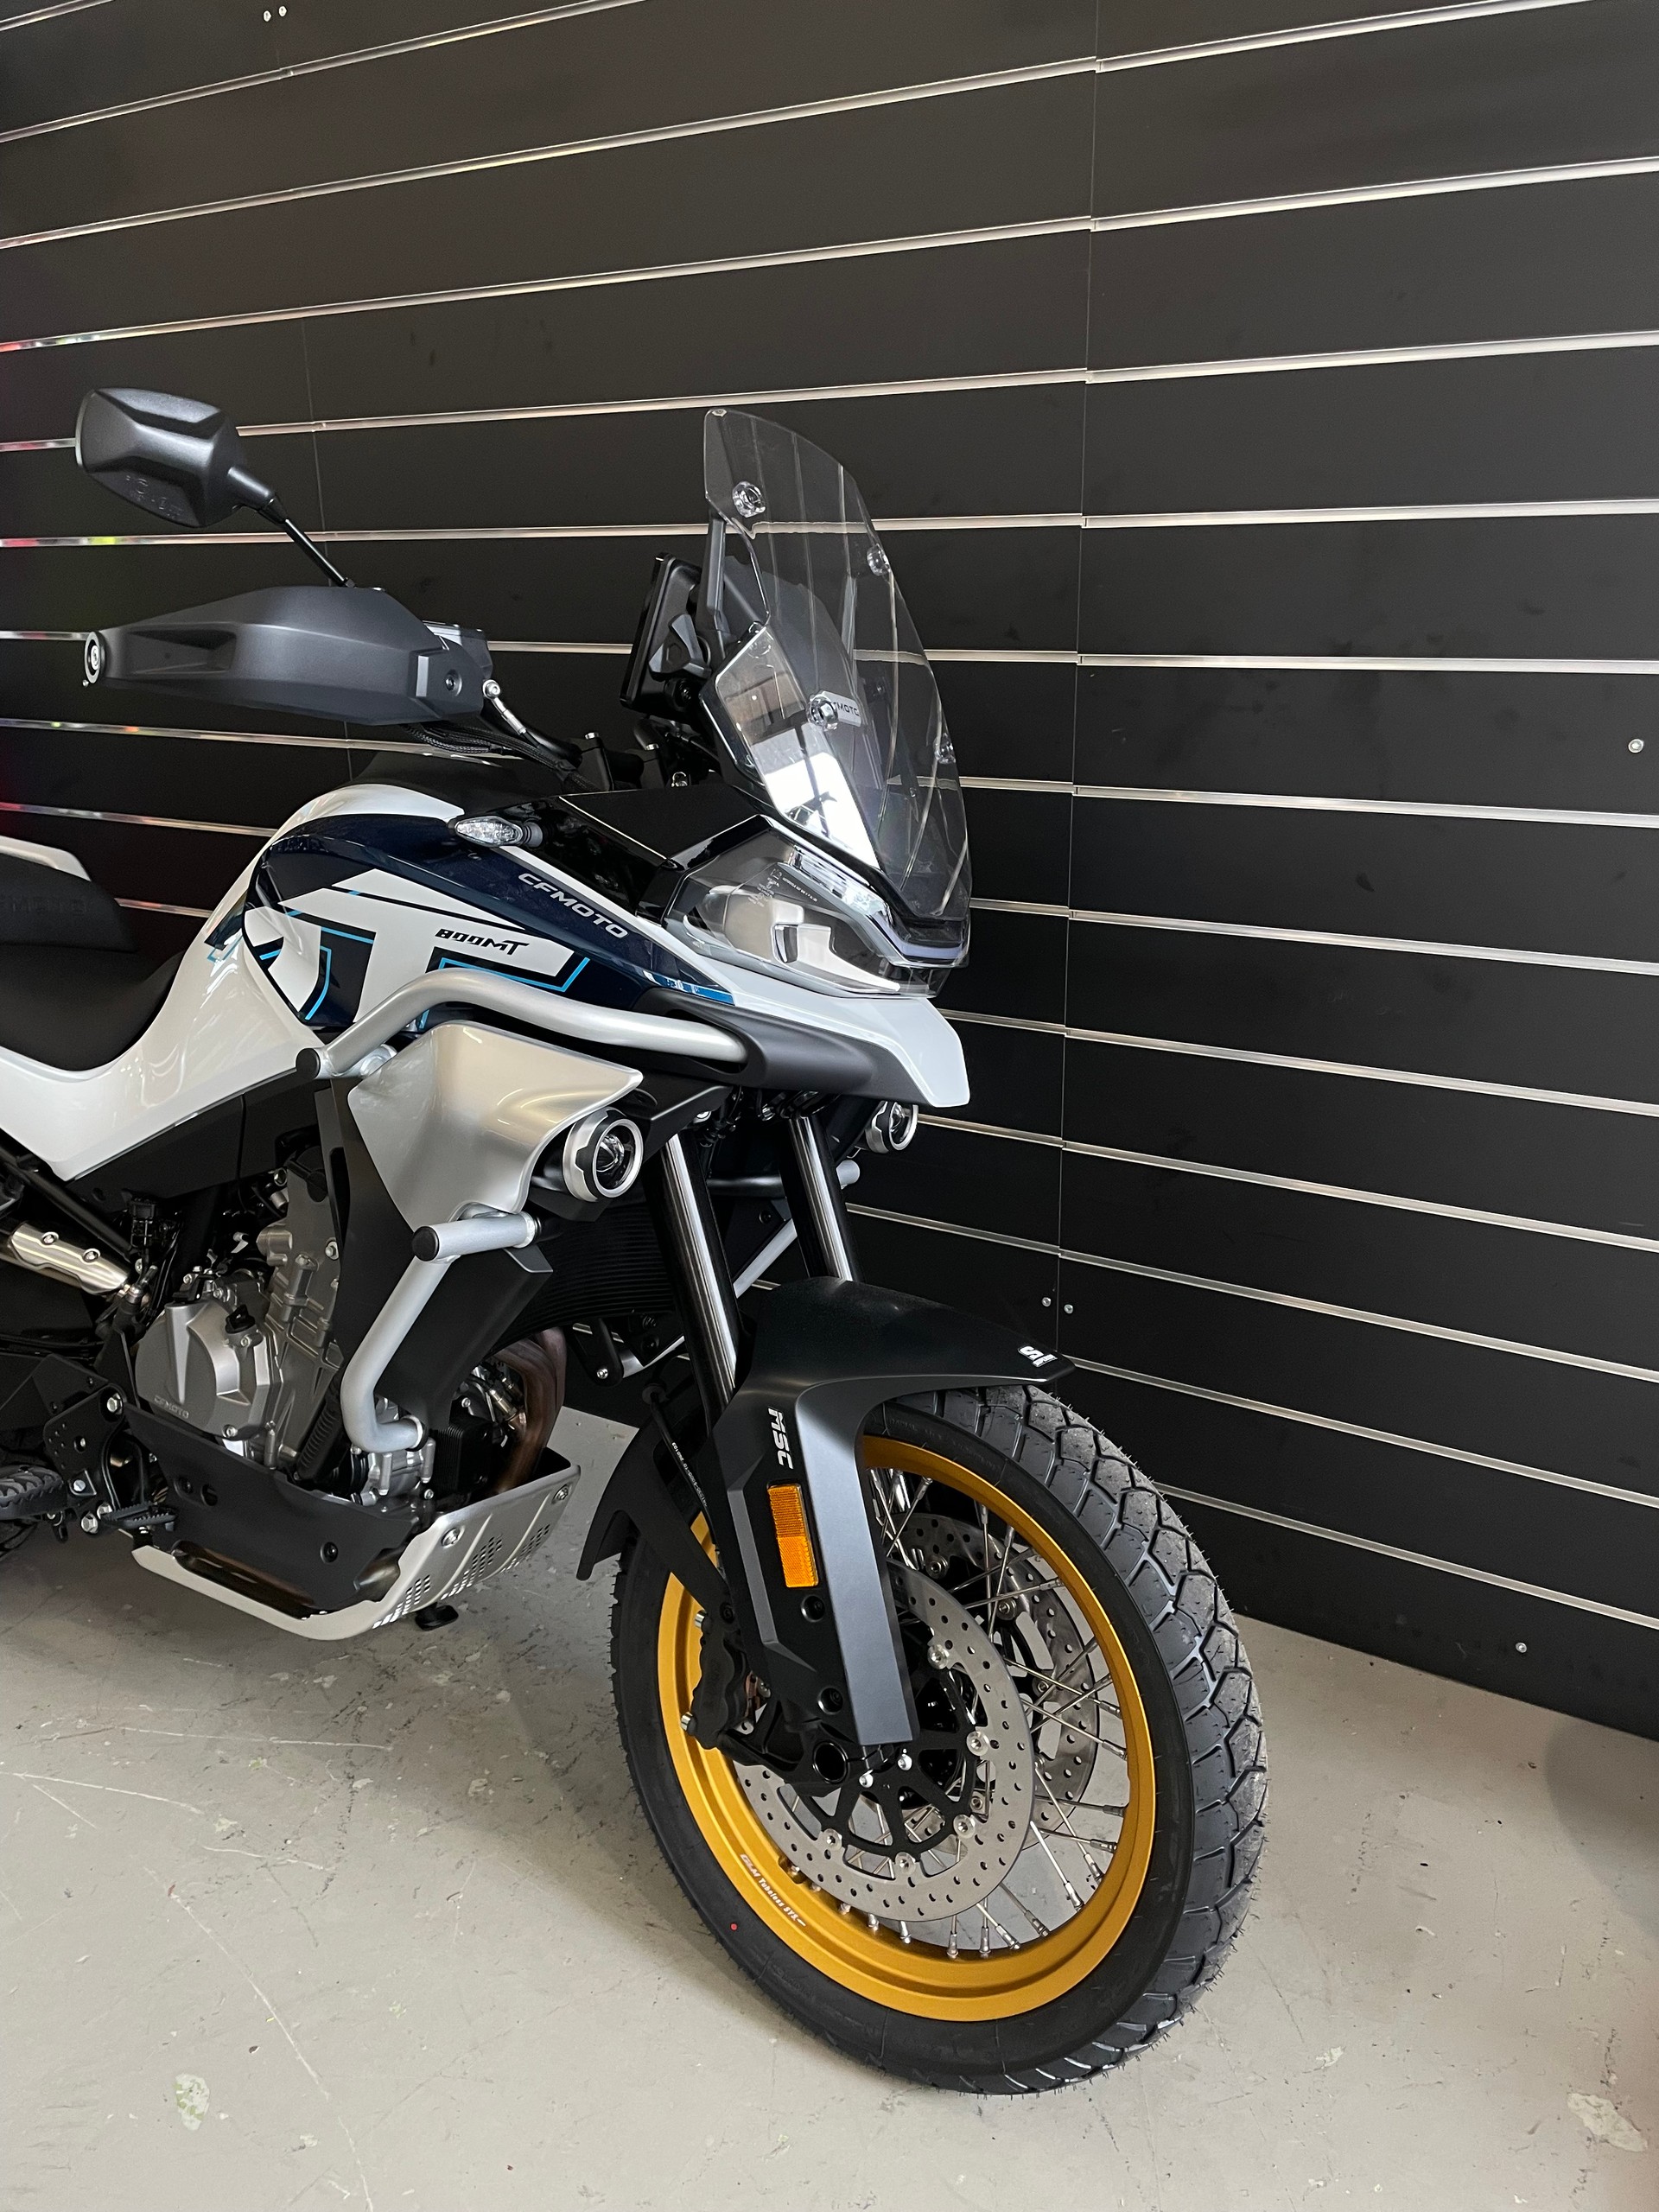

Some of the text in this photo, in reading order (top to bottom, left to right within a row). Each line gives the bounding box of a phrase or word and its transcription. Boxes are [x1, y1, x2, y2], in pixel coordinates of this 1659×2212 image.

[518, 872, 630, 939] CFMOTO
[434, 928, 531, 956] 800MT
[767, 1407, 794, 1470] MSC
[758, 1877, 785, 1908] Tubeless
